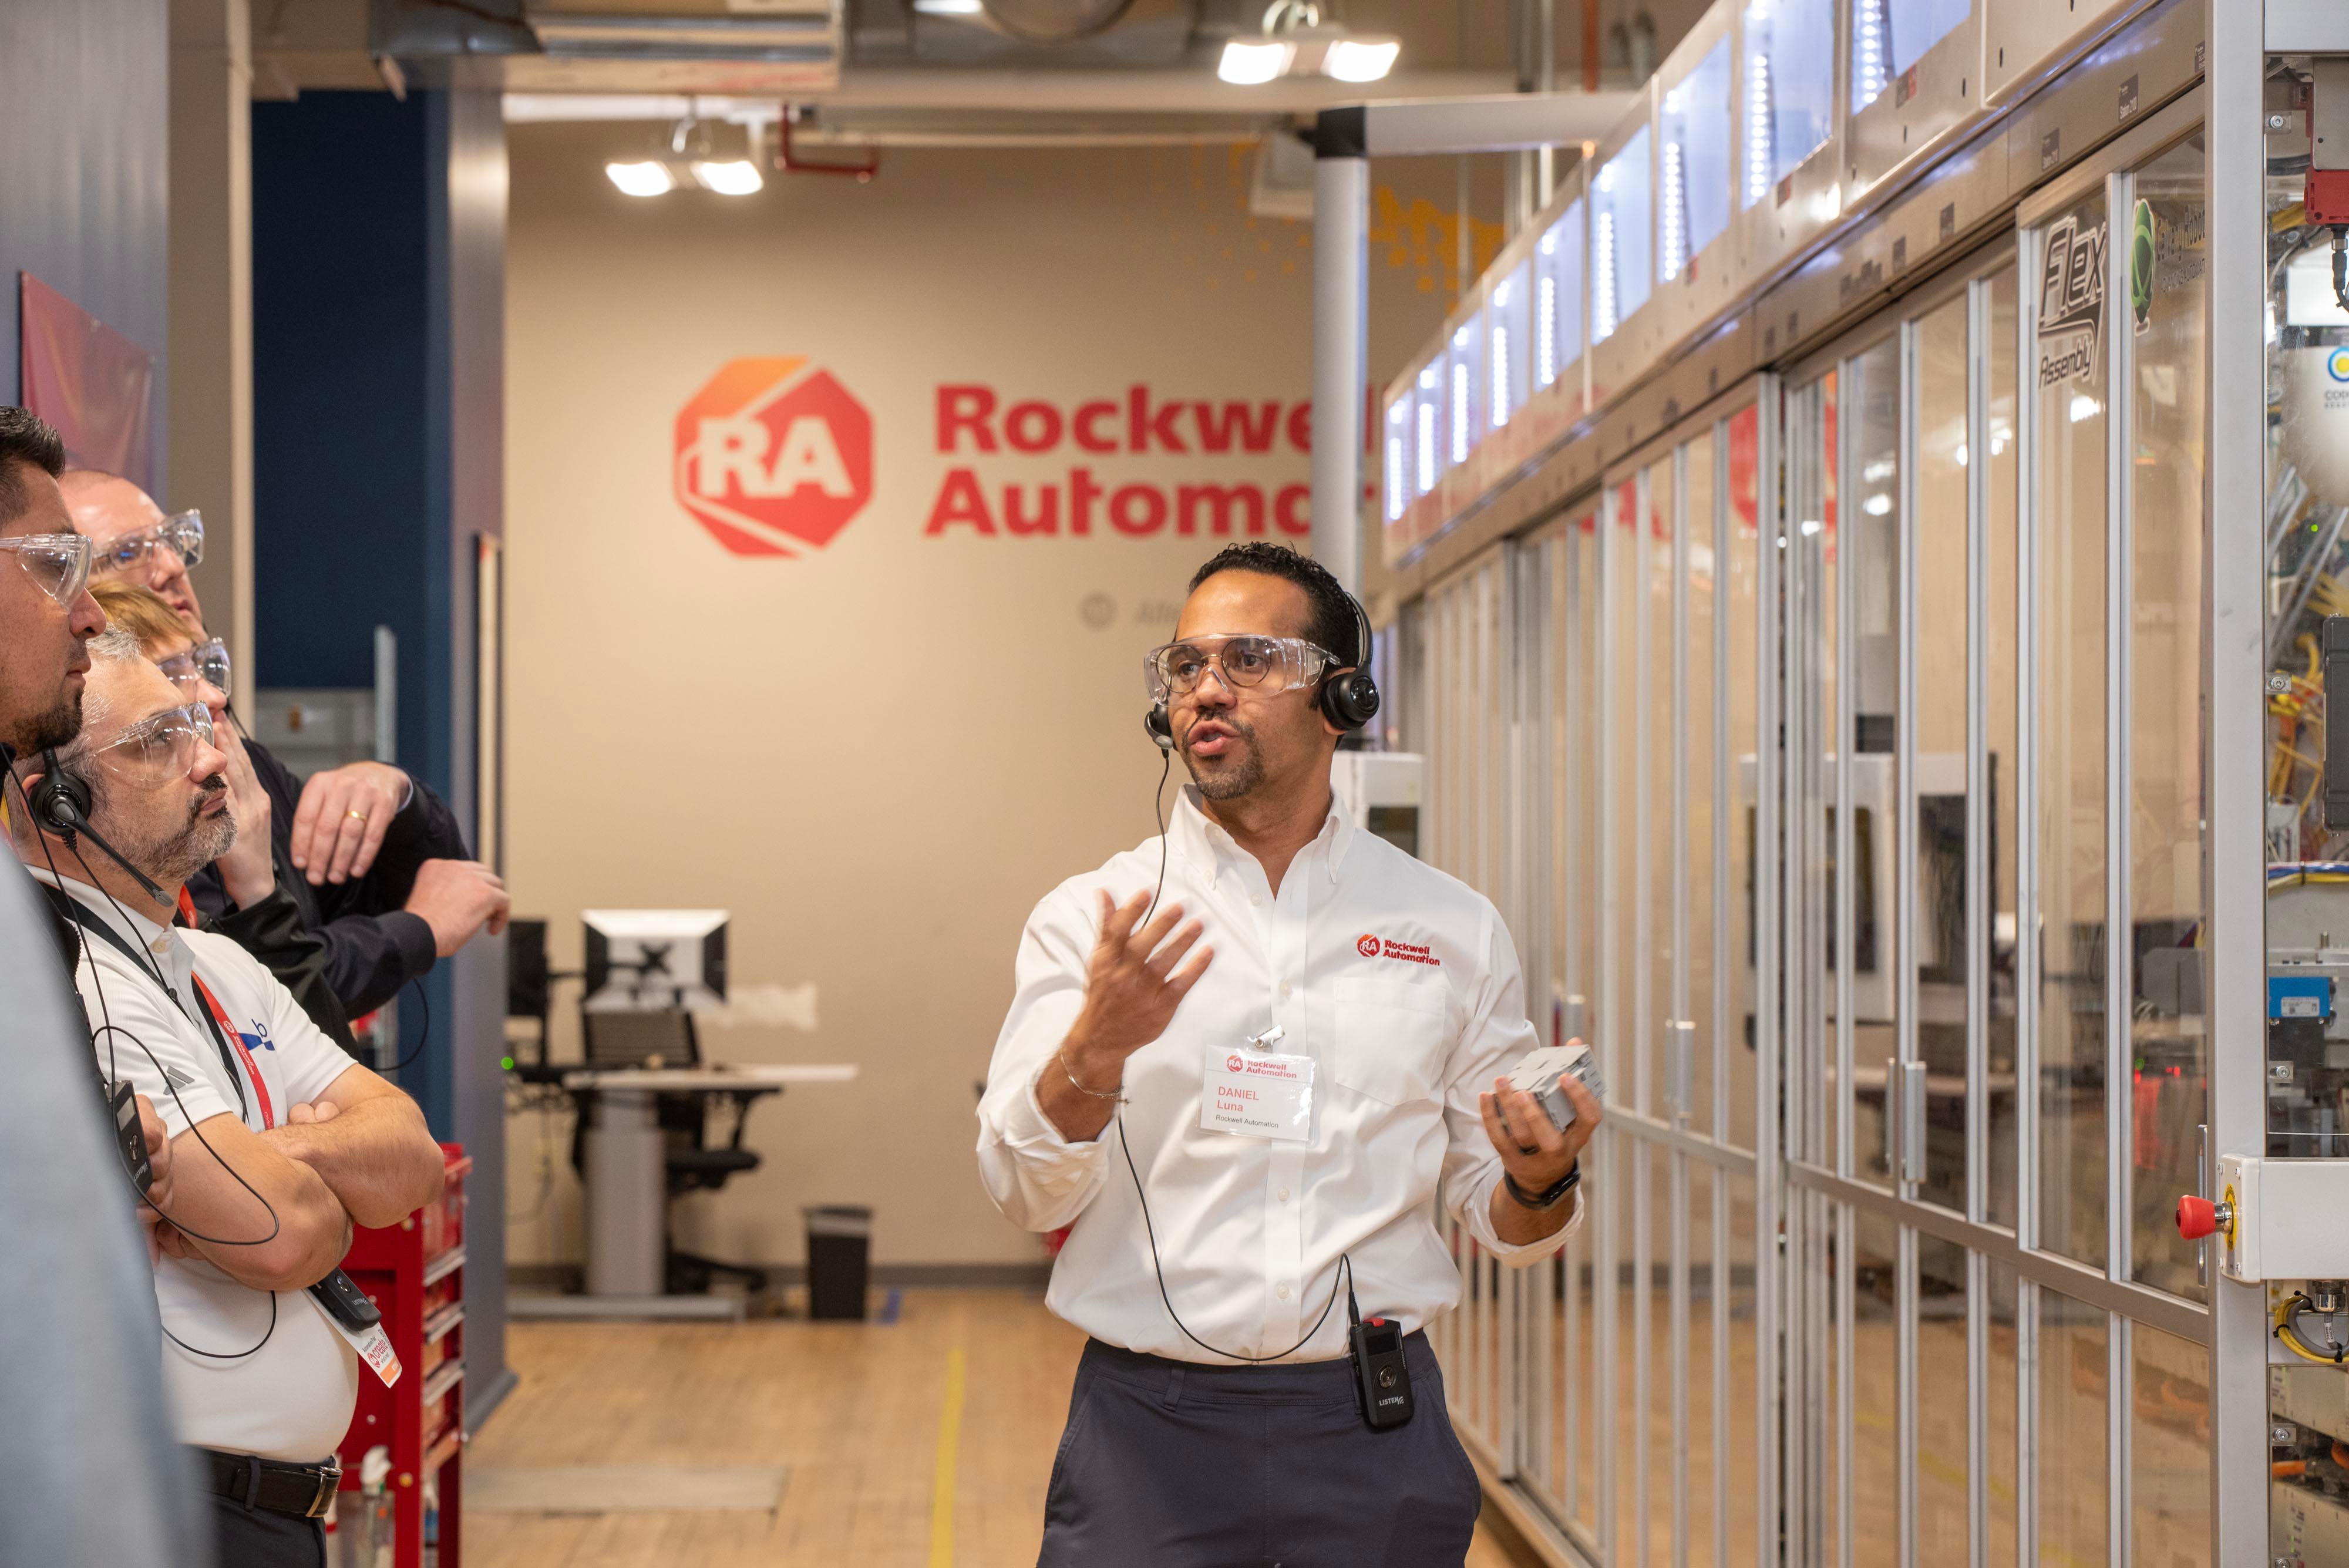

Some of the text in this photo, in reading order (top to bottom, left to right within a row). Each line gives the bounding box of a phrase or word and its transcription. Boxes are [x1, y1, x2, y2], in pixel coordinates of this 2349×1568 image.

[2040, 217, 2106, 322] Flex
[2038, 336, 2093, 389] Assembly
[1384, 940, 1430, 955] Rockwell
[1382, 949, 1440, 966] Automation
[1246, 1066, 1297, 1079] Automation
[1247, 1060, 1287, 1071] Rockwell
[1218, 1086, 1260, 1101] DANIEL
[1217, 1100, 1243, 1112] Luna
[1216, 1114, 1279, 1128] Rockwell Automation
[372, 1339, 388, 1359] create
[1379, 1397, 1398, 1406] LISTEN
